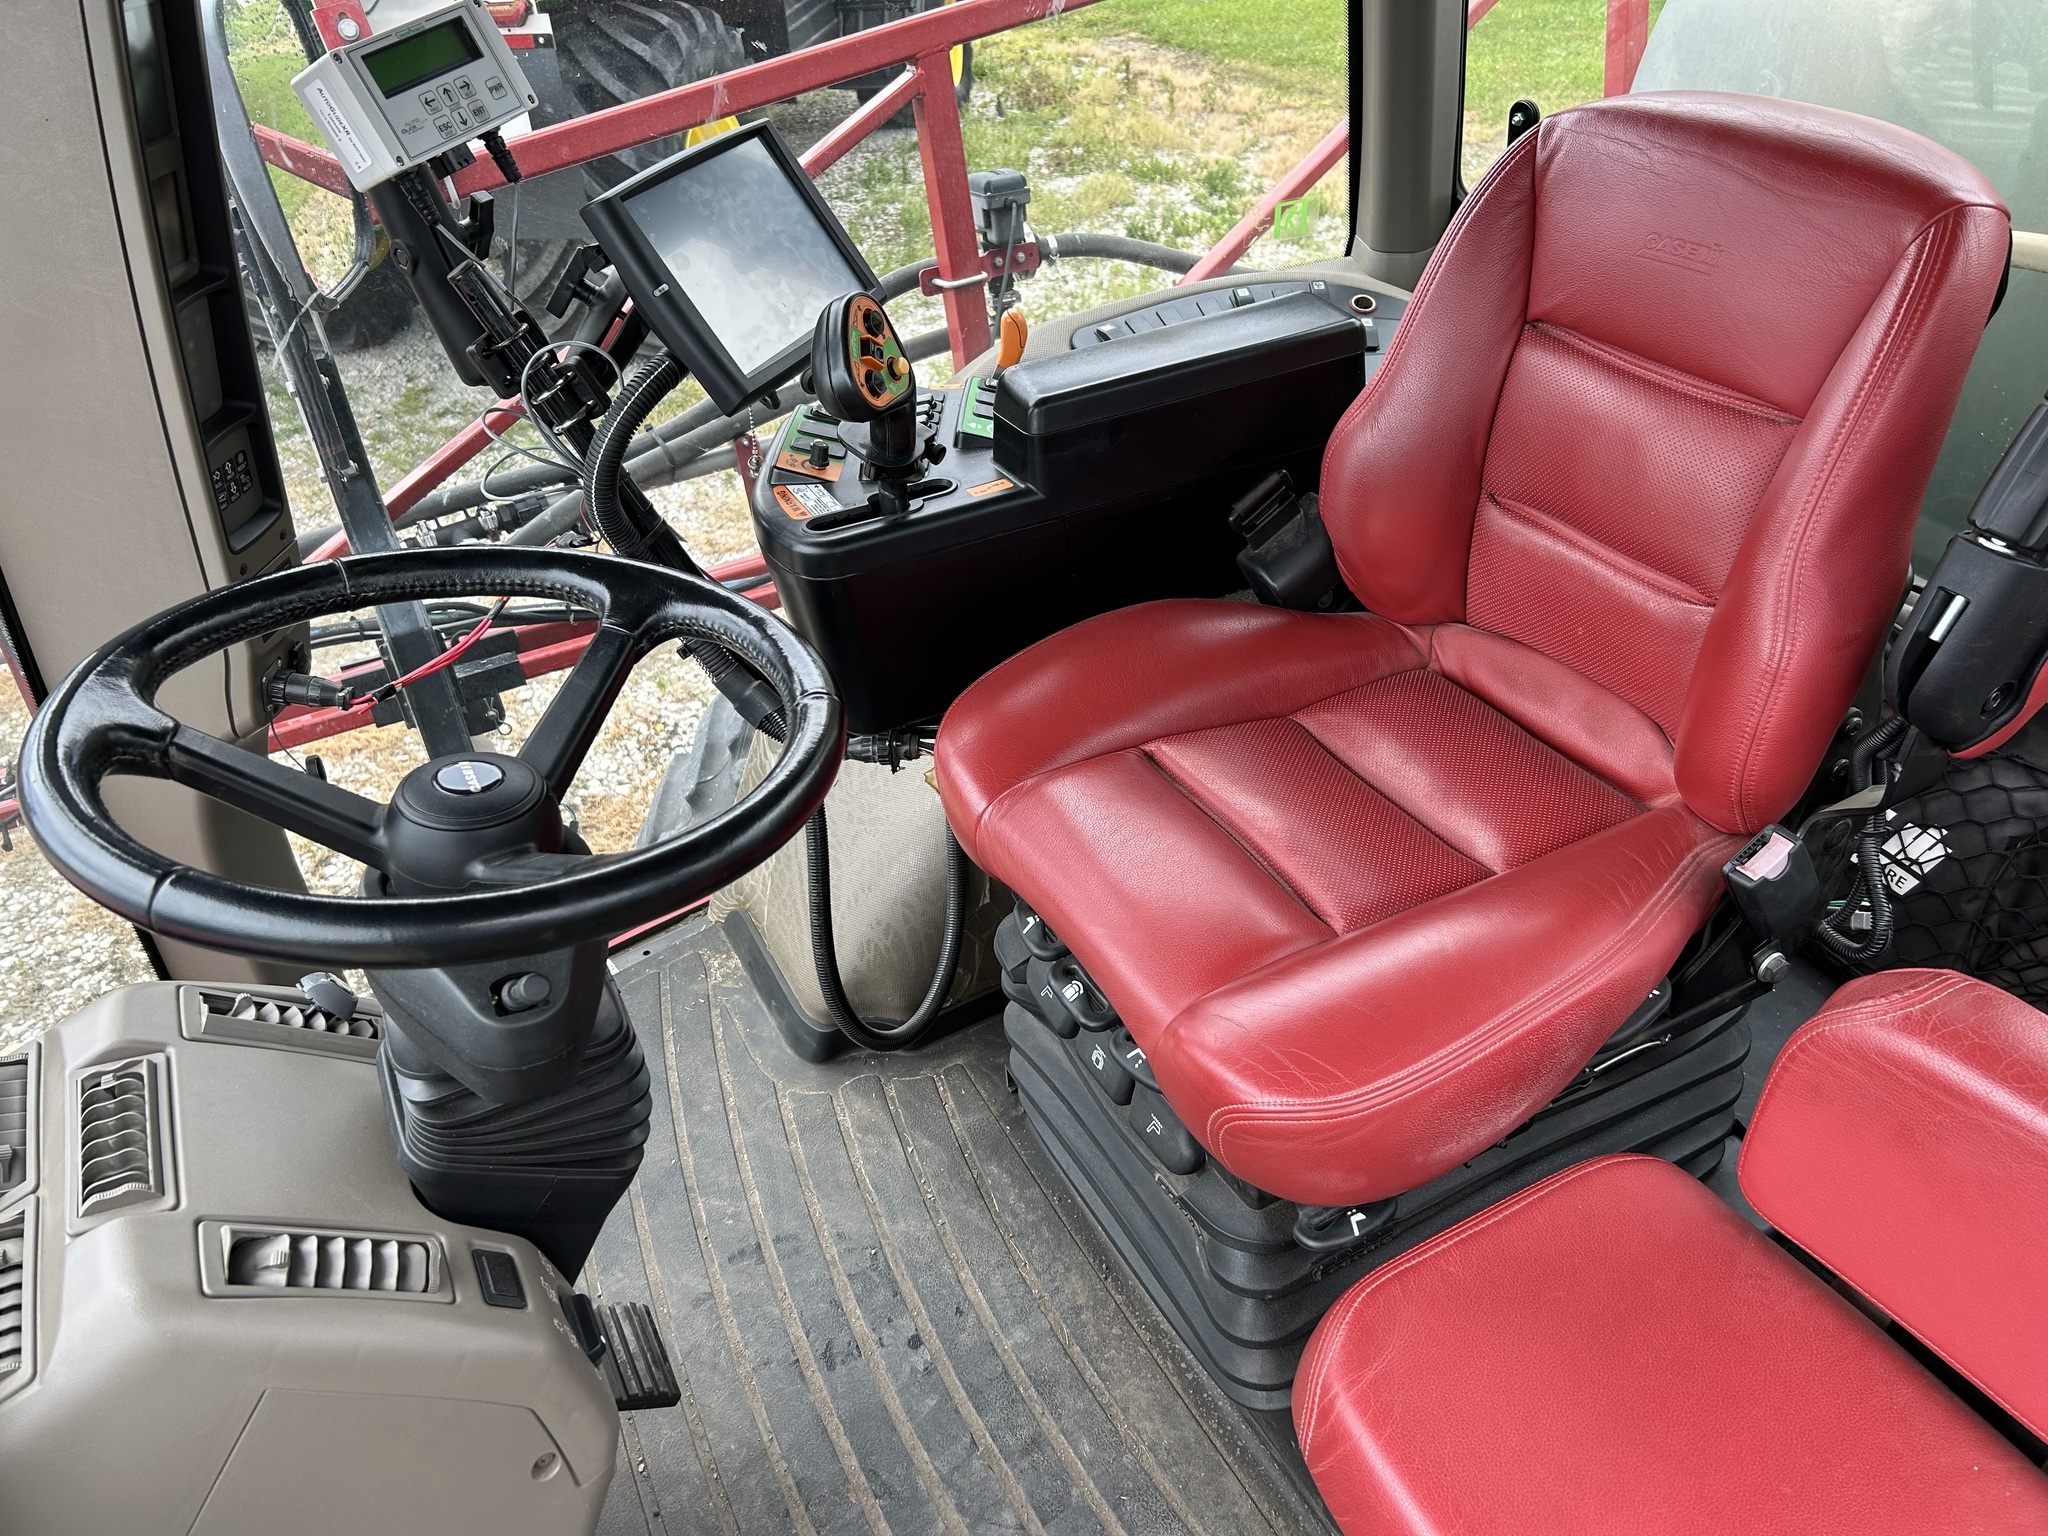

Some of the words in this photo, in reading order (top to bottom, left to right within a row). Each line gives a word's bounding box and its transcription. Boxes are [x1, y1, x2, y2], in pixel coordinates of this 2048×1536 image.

[488, 82, 505, 95] PWR
[472, 105, 486, 117] ENT
[438, 121, 453, 133] ESC
[777, 490, 800, 512] WARNING
[462, 769, 482, 792] CASE
